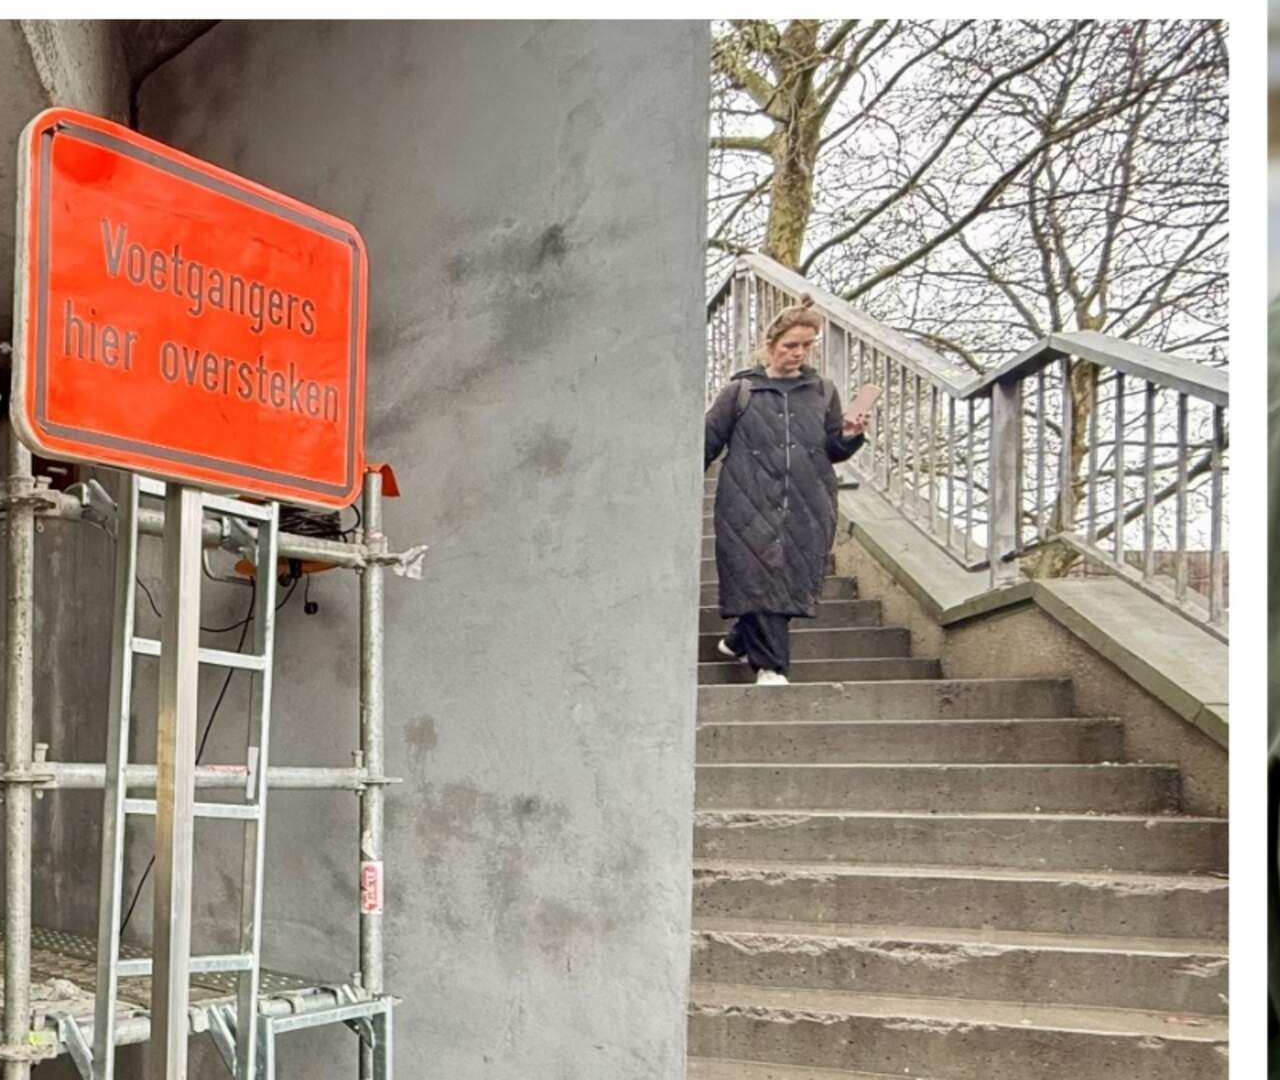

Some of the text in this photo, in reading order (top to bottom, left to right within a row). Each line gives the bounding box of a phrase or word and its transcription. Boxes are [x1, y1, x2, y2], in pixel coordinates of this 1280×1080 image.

[99, 217, 315, 336] Voetgangers
[63, 300, 339, 423] hier oversteken
